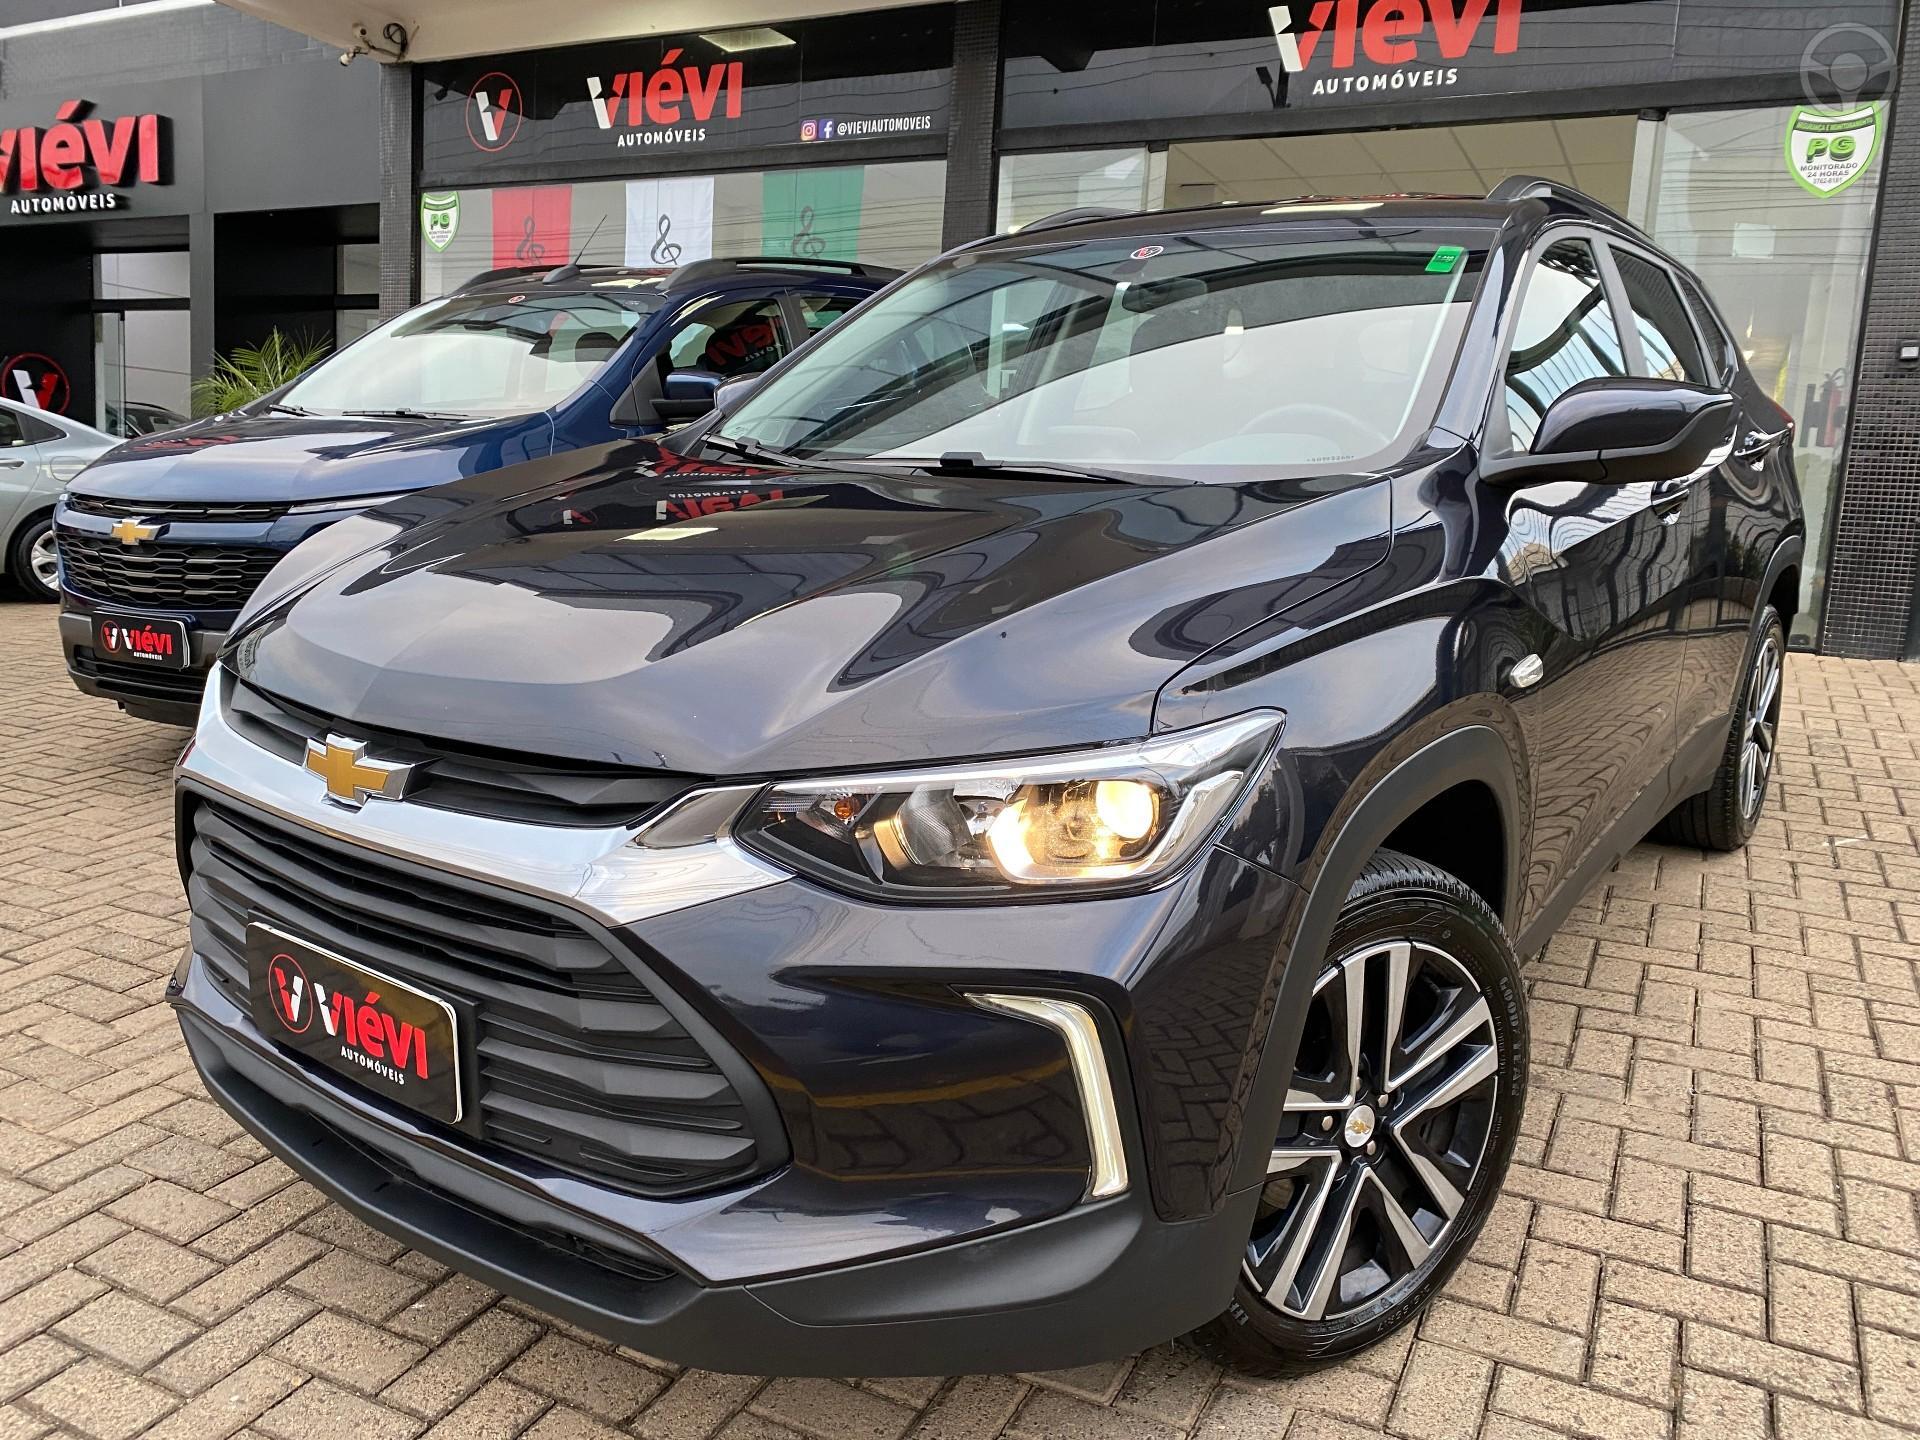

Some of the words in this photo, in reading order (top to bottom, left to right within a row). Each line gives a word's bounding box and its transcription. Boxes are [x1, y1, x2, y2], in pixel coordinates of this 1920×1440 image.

[1312, 68, 1458, 95] AUTOMÓVEIS
[837, 116, 931, 136] @VIEVIAUTOMOVEIS
[617, 128, 706, 147] AUTOMÓVEIS
[1800, 162, 1858, 172] MONITORADO
[11, 191, 116, 214] AUTOMÓVEIS
[340, 1045, 405, 1085] AUTOMÓVEIS
